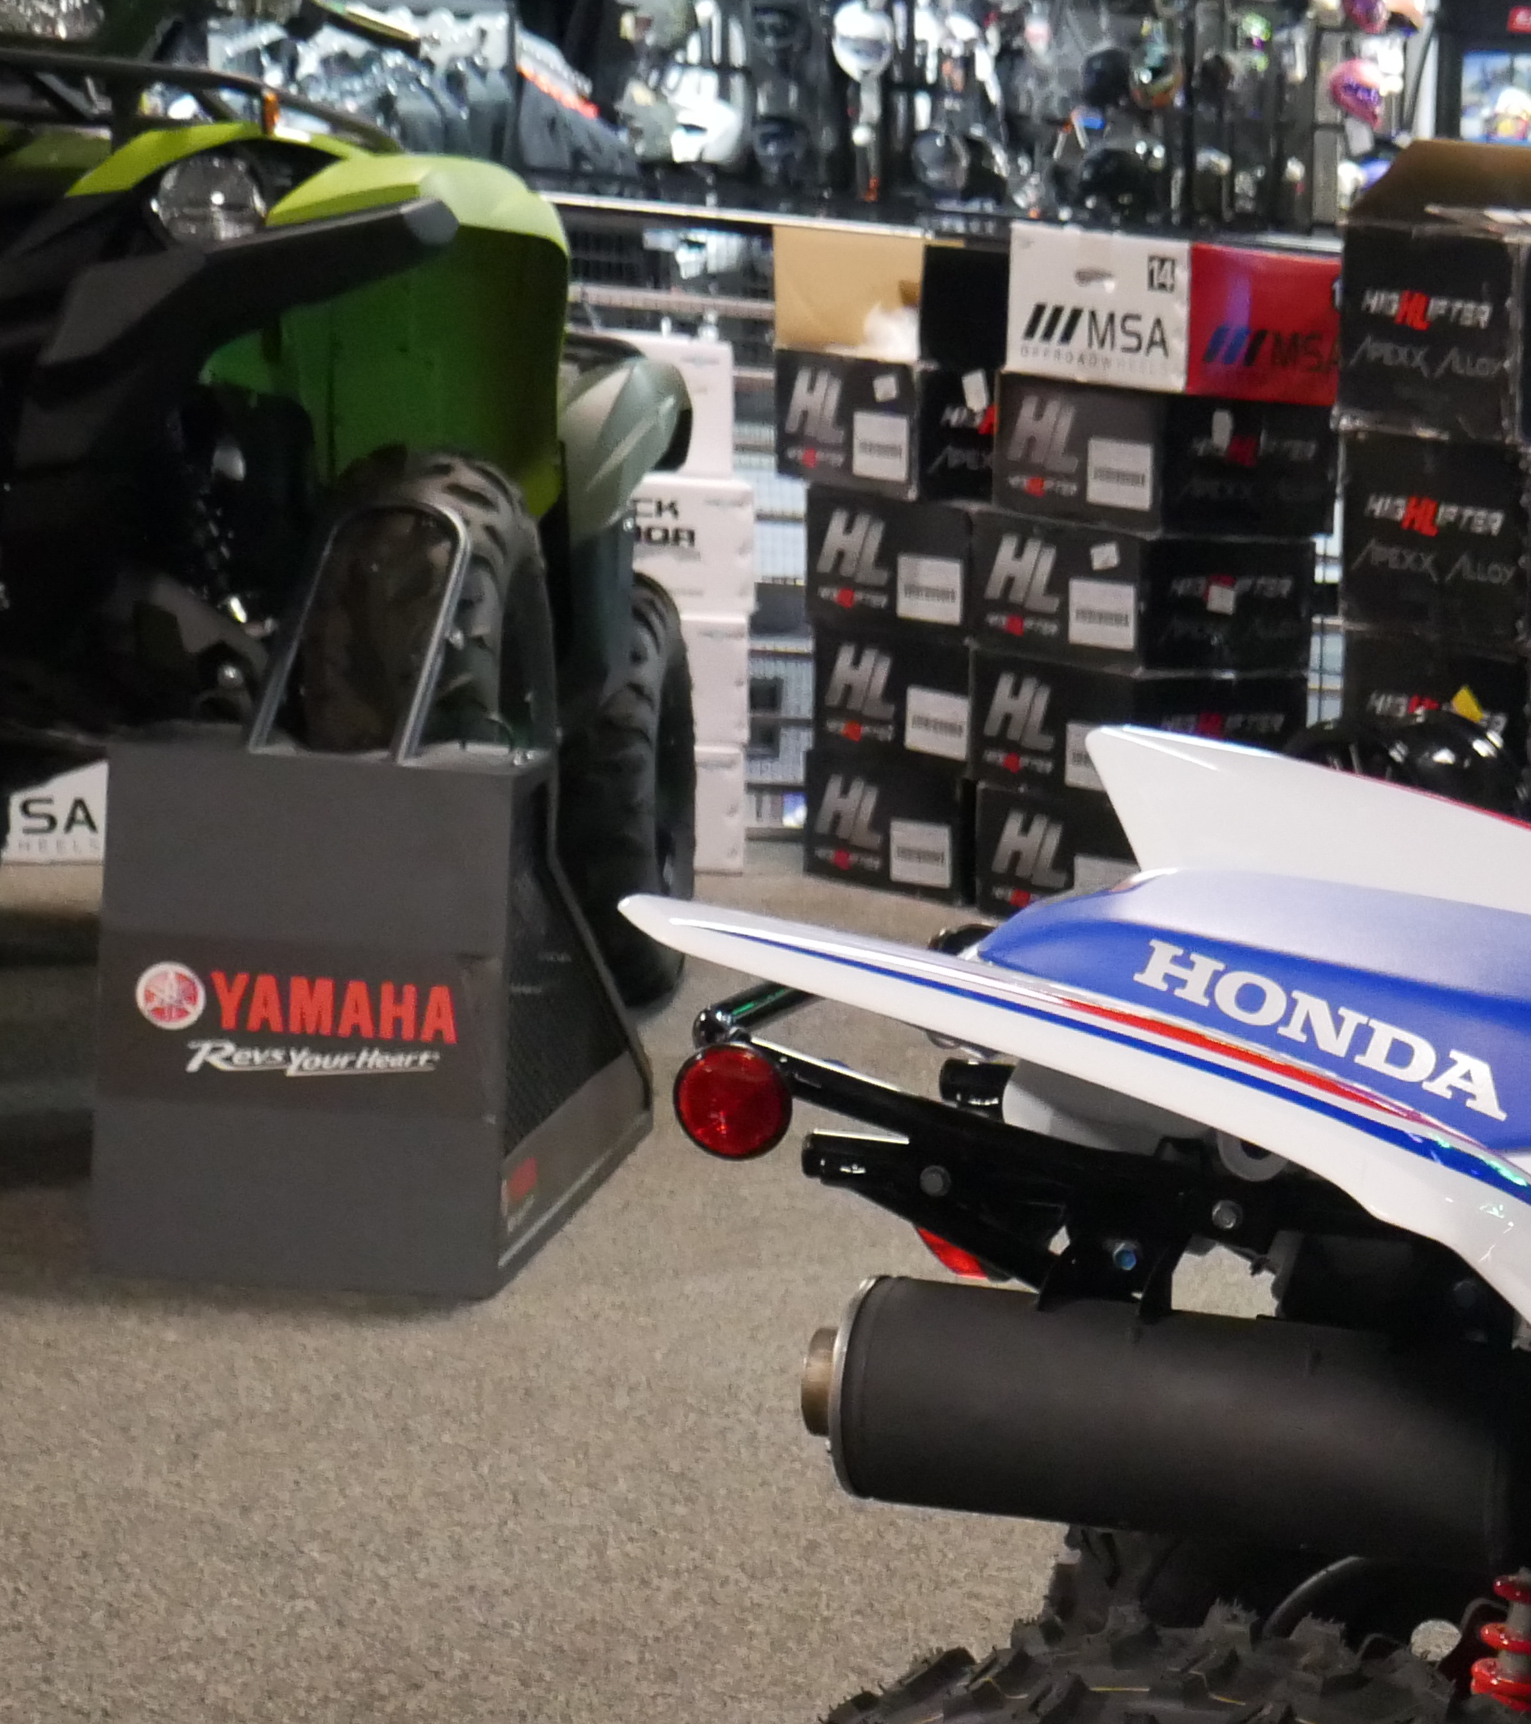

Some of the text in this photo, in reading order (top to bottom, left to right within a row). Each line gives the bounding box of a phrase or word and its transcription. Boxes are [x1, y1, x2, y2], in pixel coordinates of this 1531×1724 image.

[1088, 310, 1169, 358] MSA
[816, 508, 890, 585] HL
[984, 534, 1060, 613] HL
[824, 642, 895, 720] HL
[984, 671, 1055, 751] HL
[20, 797, 98, 834] SA
[815, 774, 883, 850] HL
[992, 809, 1067, 888] HL
[210, 969, 458, 1045] YAMAHA
[1133, 939, 1507, 1122] HONDA
[185, 1038, 440, 1078] Revs Your Heart
